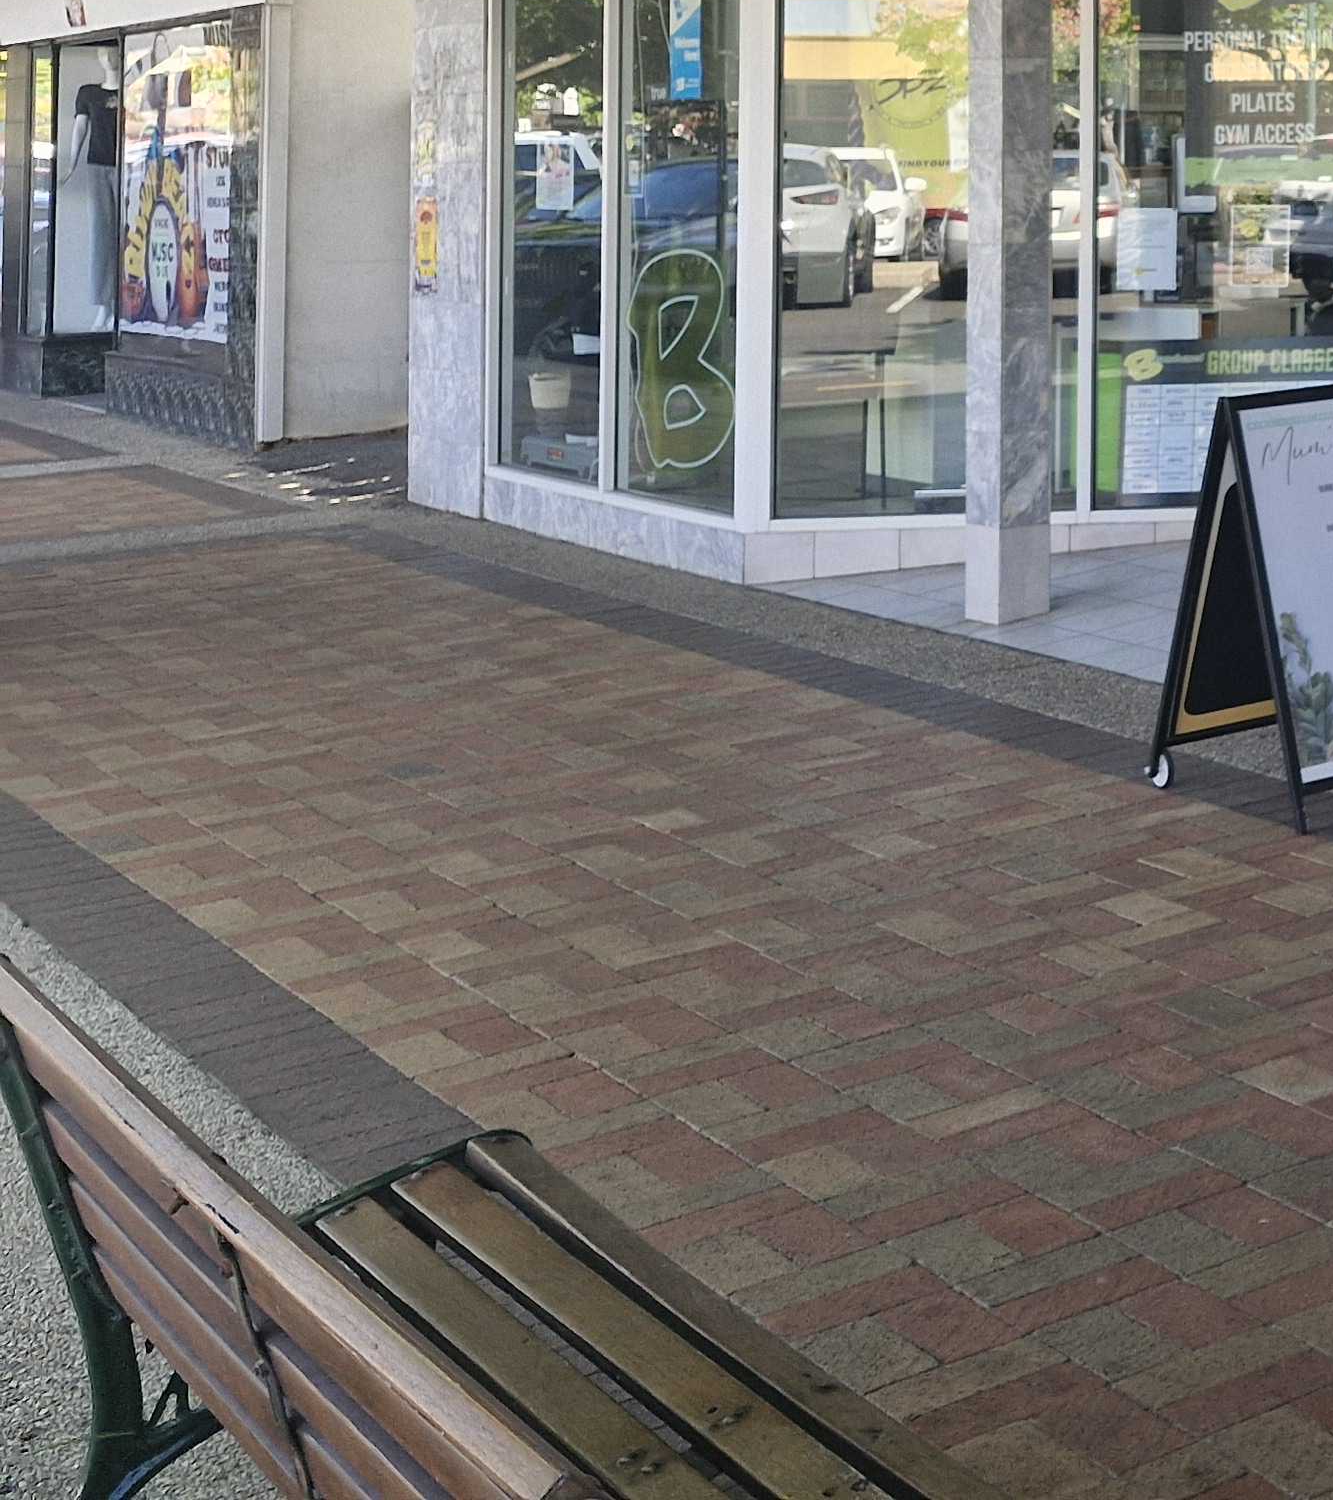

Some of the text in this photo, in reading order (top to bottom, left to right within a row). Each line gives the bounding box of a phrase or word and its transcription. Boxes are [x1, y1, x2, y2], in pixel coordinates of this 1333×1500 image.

[1184, 30, 1265, 51] PERSONAL
[1231, 92, 1296, 113] PILATES
[1214, 123, 1316, 145] GYM ACCESS
[1207, 350, 1266, 376] GROUP
